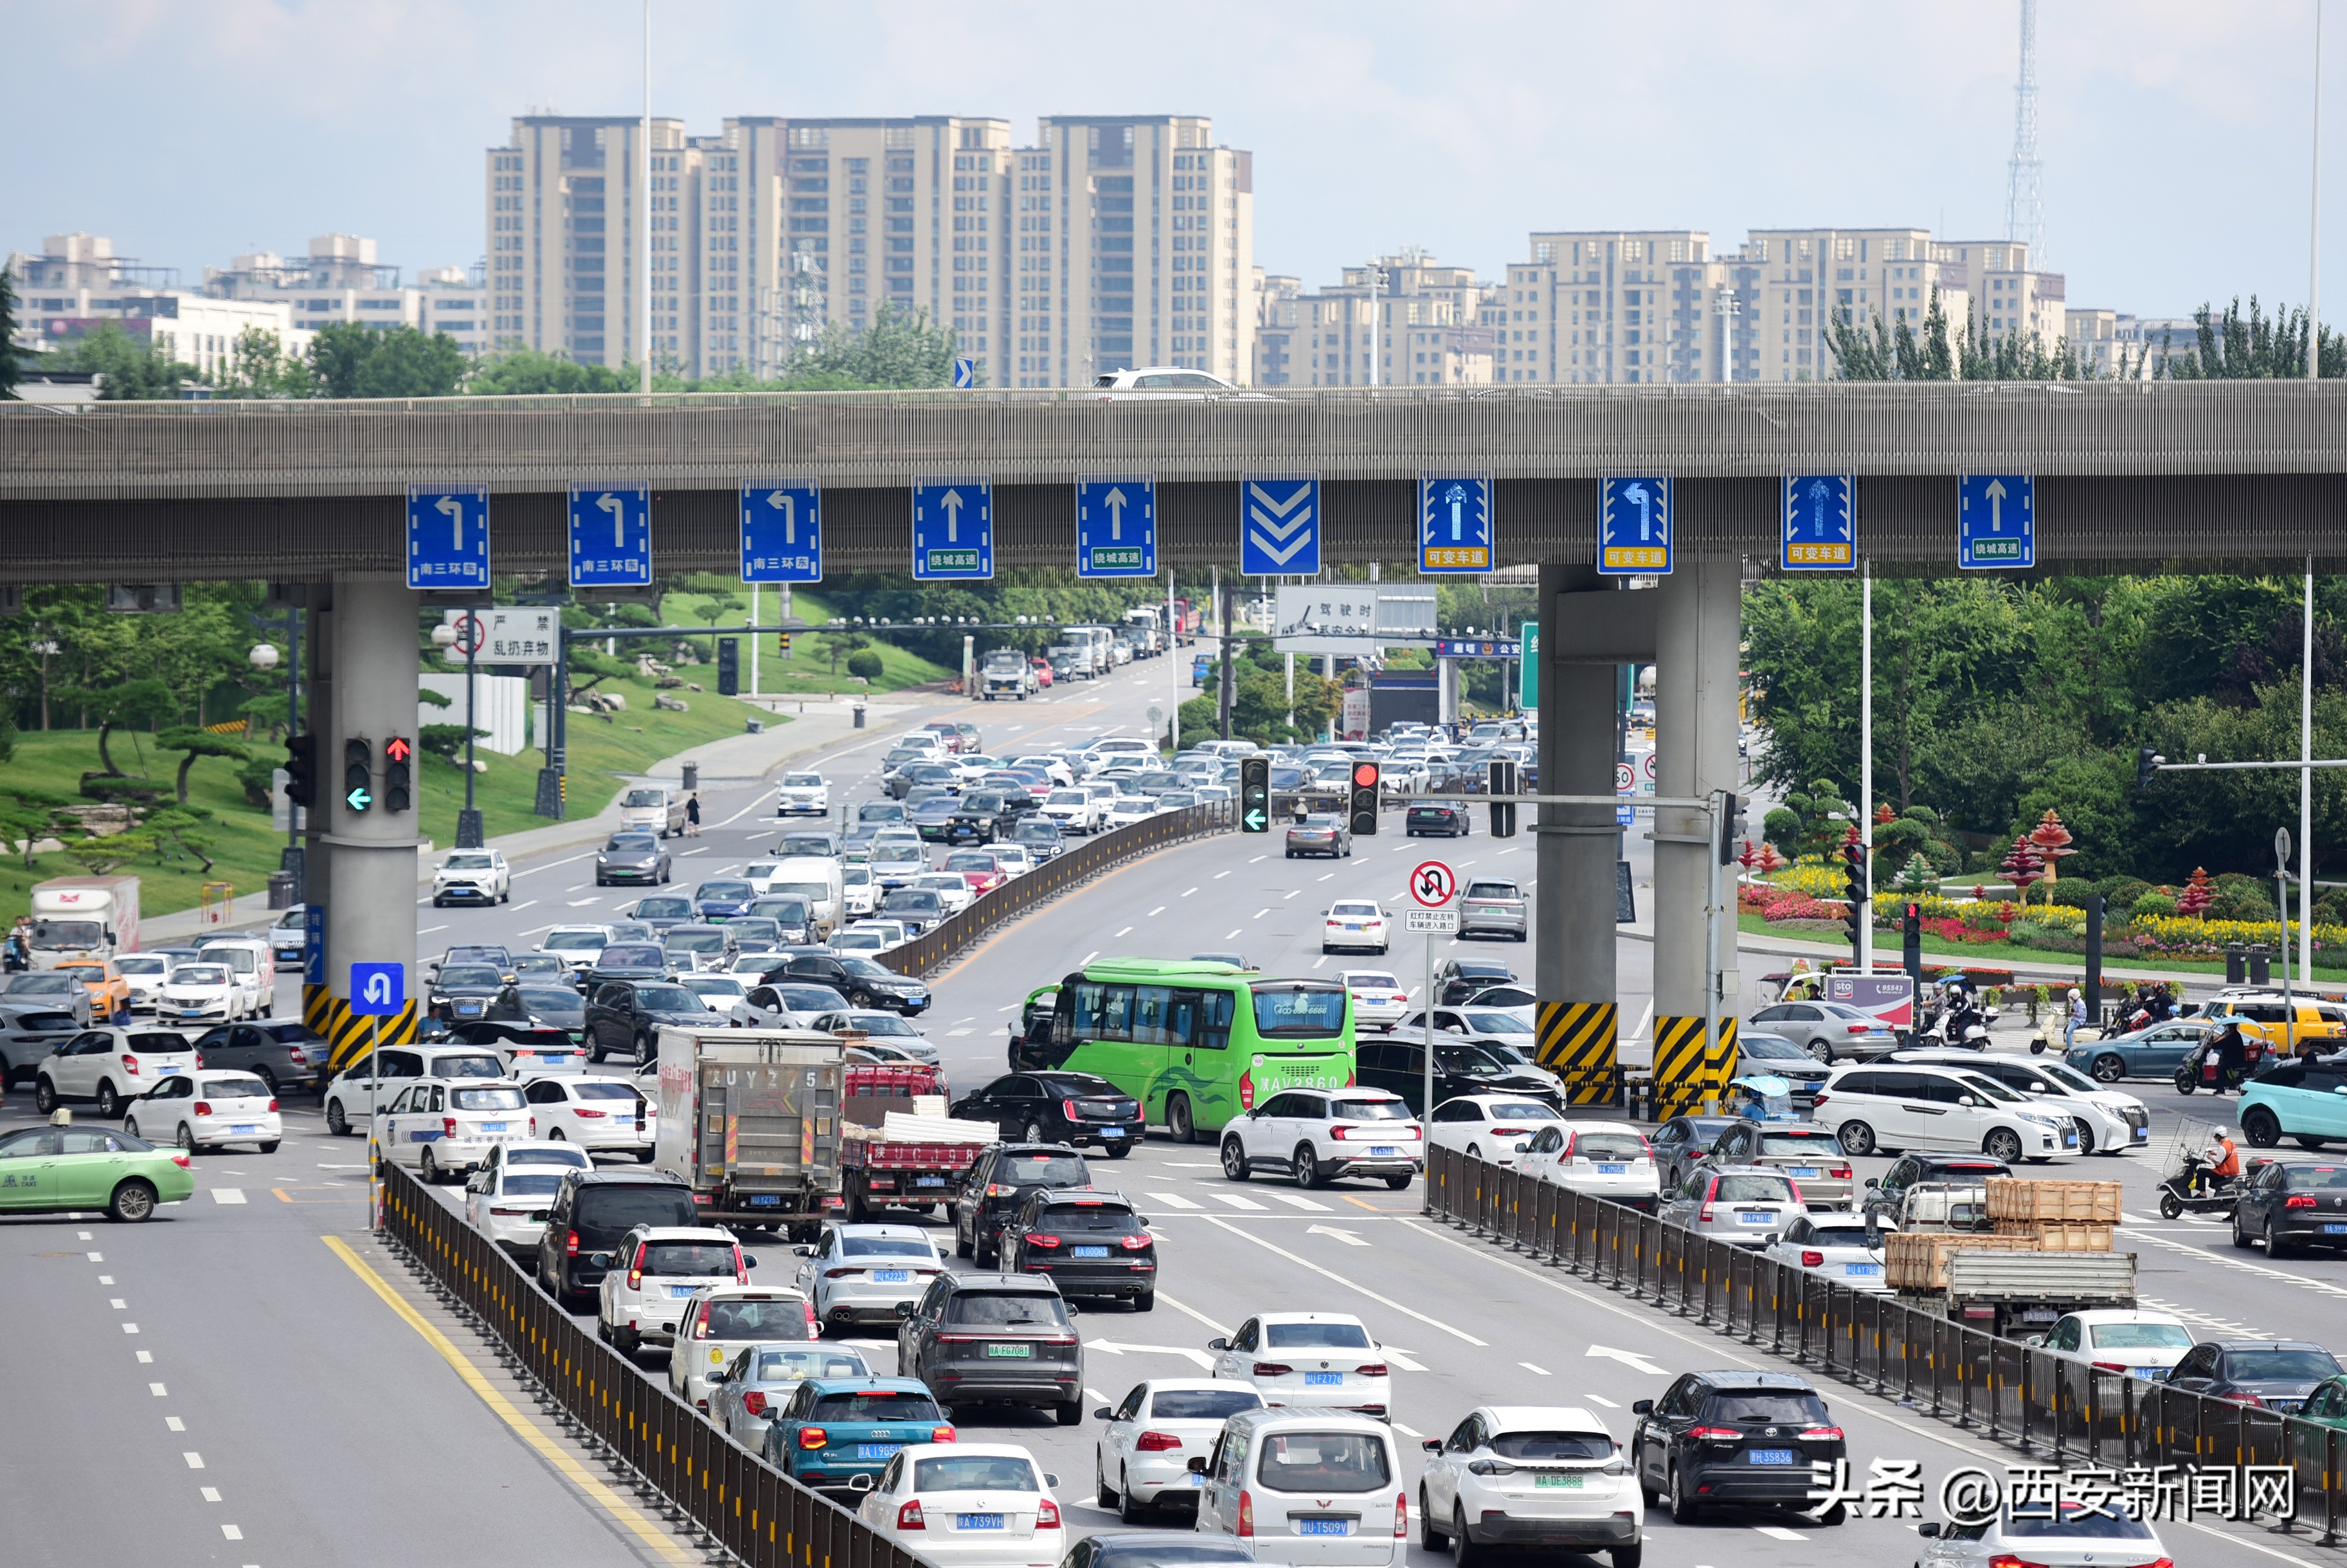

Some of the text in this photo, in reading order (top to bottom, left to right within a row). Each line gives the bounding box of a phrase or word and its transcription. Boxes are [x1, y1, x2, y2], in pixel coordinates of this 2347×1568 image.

[1791, 545, 1847, 563] 可变车道
[1974, 539, 2020, 557] 绕城高速
[753, 556, 809, 570] 南三环东
[930, 554, 976, 567] 绕城高速
[1094, 552, 1140, 565] 绕城高速
[1428, 548, 1485, 566] 可变车道
[1607, 548, 1664, 566] 可变车道
[420, 561, 476, 576] 南三环东
[582, 559, 639, 573] 南三环东
[1320, 602, 1372, 617] 驾驶时
[492, 640, 549, 657] 乱扔弃物
[1410, 912, 1454, 921] 红灯禁止左转
[1409, 921, 1453, 930] 车辆进入路口
[1836, 982, 1851, 991] sto
